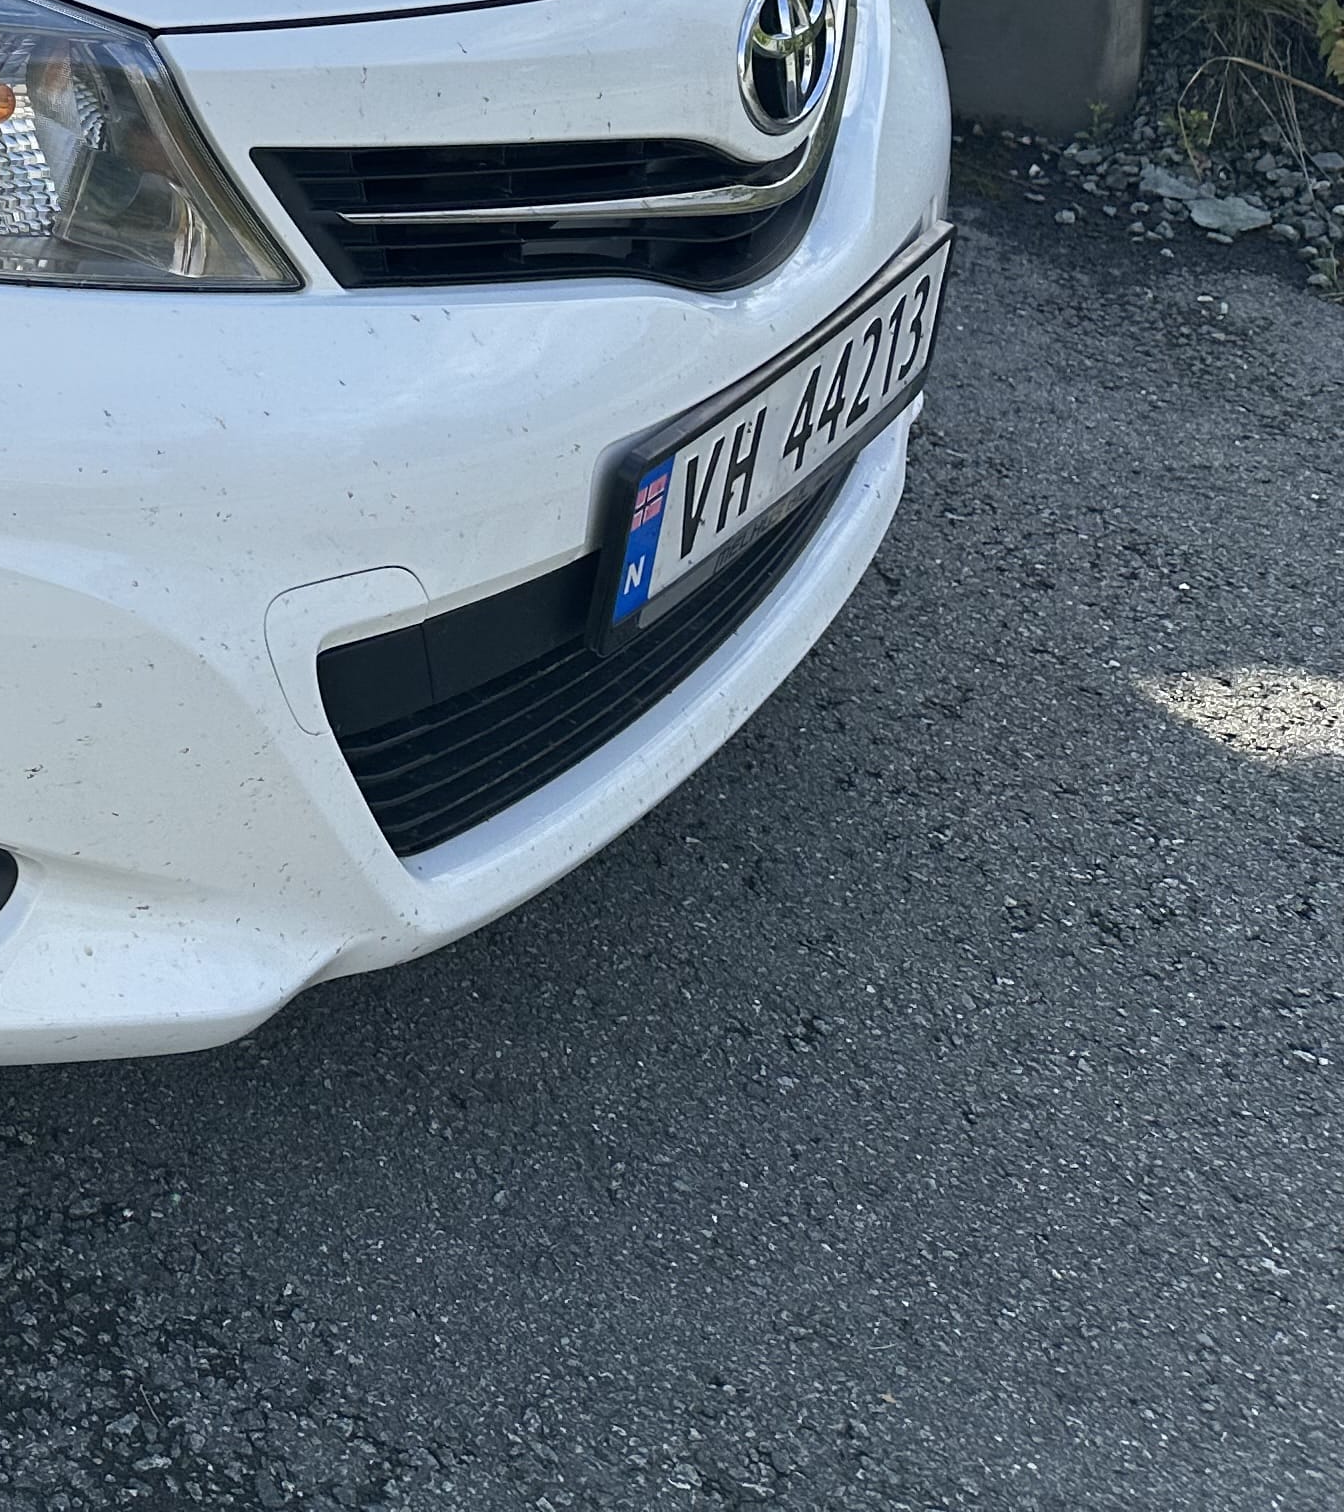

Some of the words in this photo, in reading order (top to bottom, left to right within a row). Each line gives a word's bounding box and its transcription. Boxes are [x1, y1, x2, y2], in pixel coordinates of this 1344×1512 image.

[680, 406, 767, 560] VH
[782, 274, 932, 472] 44213
[623, 555, 645, 596] N
